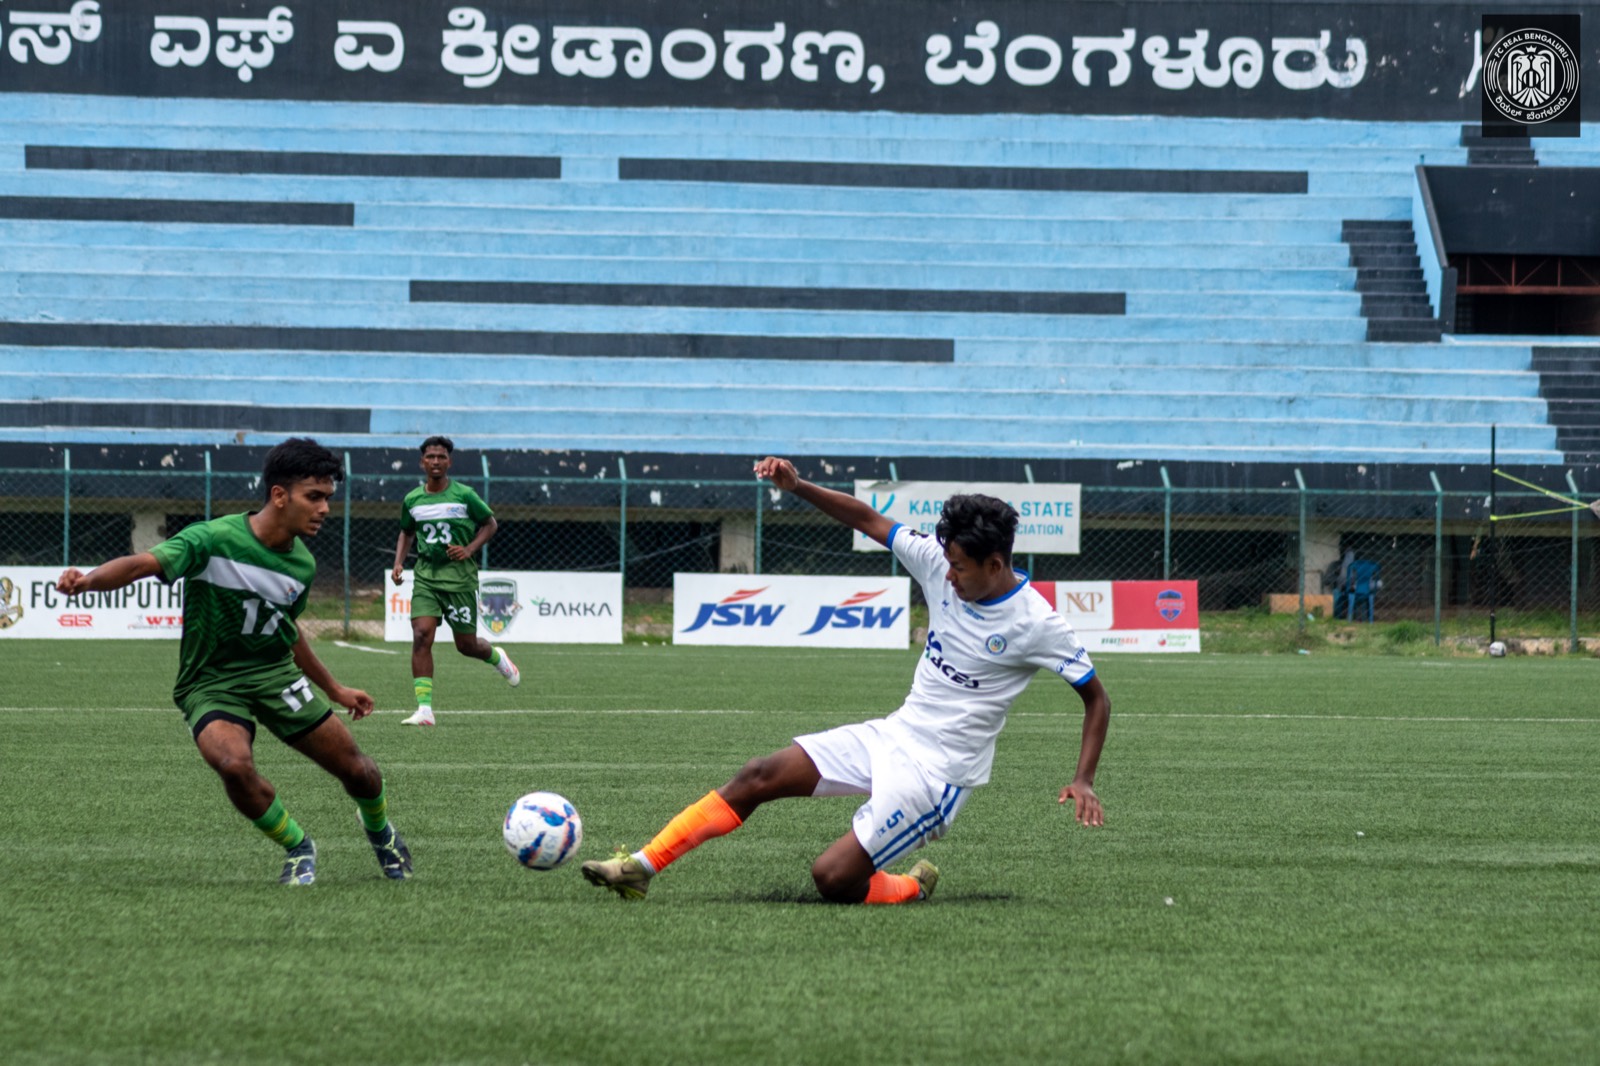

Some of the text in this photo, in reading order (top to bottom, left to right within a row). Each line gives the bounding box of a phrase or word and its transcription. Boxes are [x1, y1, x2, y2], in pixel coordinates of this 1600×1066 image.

[0, 0, 102, 65] ಸ್
[441, 7, 885, 93] ಕ್ರೀಡಾಂಗಣ,
[925, 20, 1368, 90] ಬೆಂಗಳೂರು
[1021, 502, 1073, 517] STATE
[423, 522, 452, 544] 23
[1015, 524, 1063, 535] CIATION
[31, 581, 58, 609] FC
[241, 600, 284, 635] 17
[447, 605, 472, 624] 23
[680, 603, 786, 633] JSW
[798, 605, 905, 636] JSW
[281, 676, 314, 713] 17
[886, 809, 905, 829] 5
